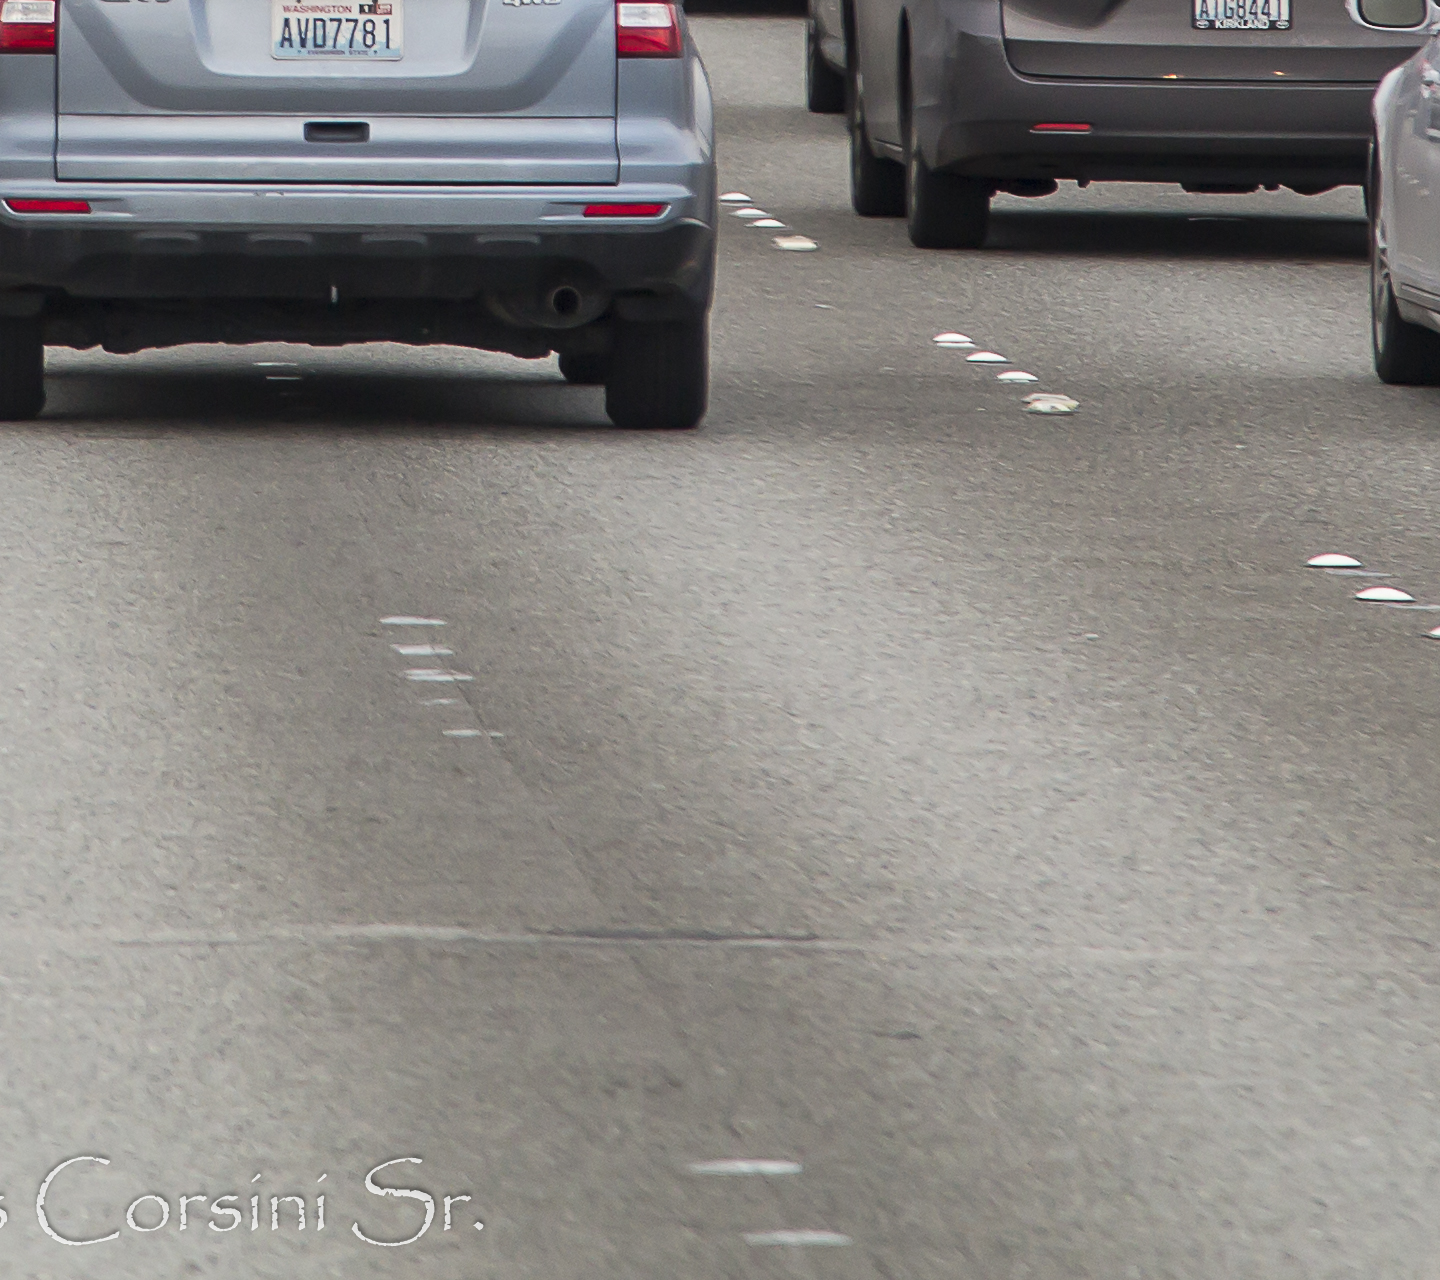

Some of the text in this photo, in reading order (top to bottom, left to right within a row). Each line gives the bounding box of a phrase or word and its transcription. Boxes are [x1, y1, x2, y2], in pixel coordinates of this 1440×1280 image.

[282, 4, 353, 14] WASHINGTON
[1215, 19, 1270, 29] KIRKLAND
[279, 17, 391, 49] AVD7781
